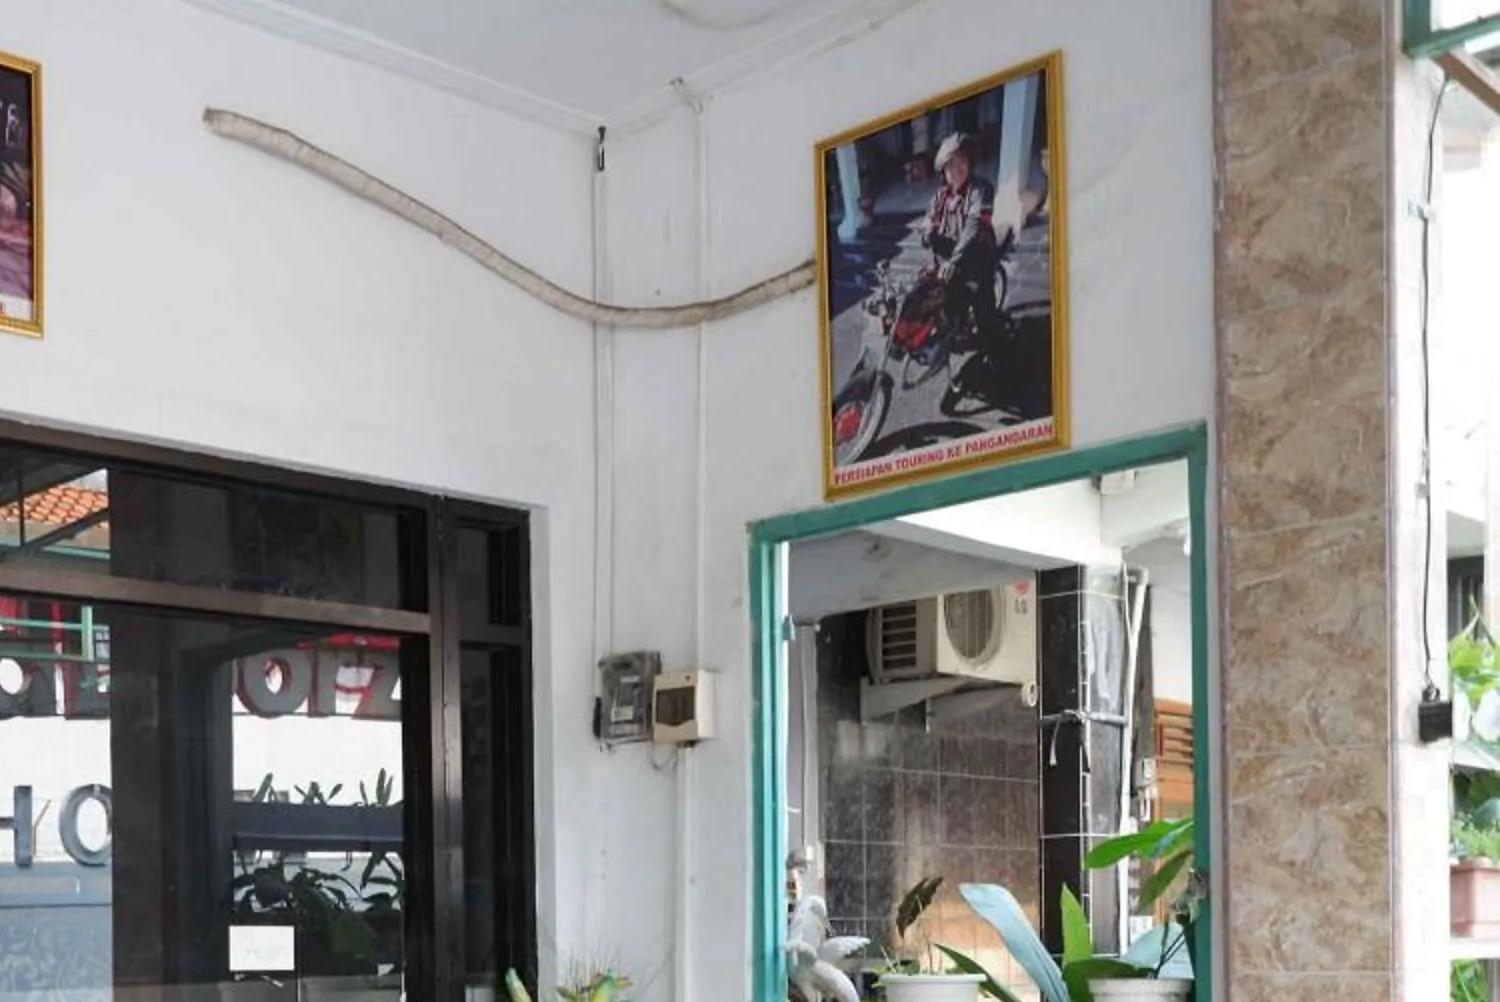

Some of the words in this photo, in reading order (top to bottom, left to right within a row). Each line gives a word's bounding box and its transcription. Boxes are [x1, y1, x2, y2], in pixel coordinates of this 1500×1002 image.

[834, 462, 894, 486] PERSIAPAN
[895, 451, 944, 471] TOURING
[947, 446, 962, 459] KE
[965, 424, 1055, 454] PANGANDARAN
